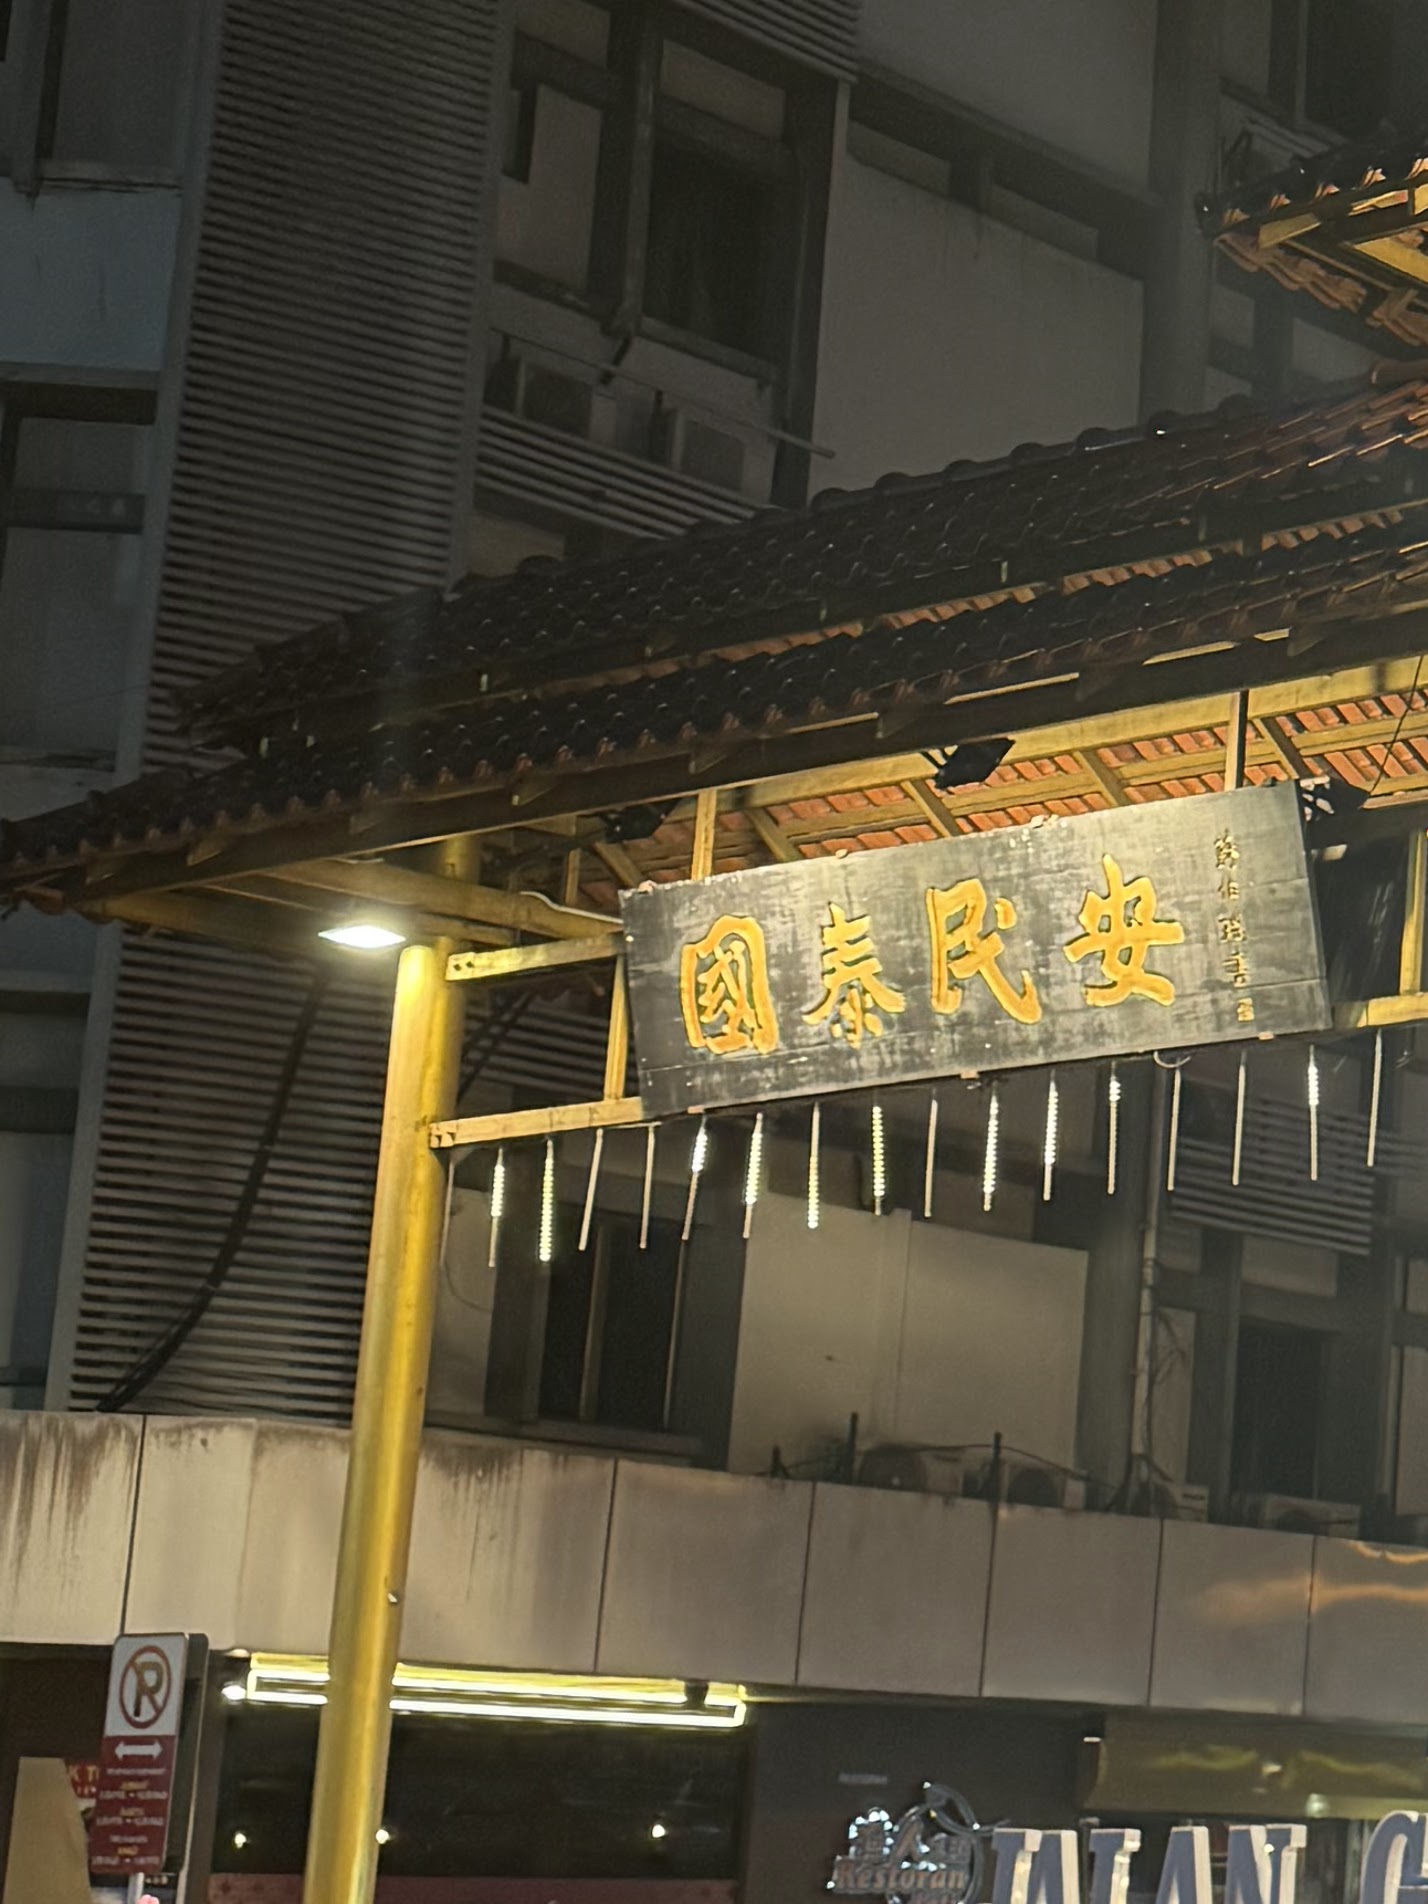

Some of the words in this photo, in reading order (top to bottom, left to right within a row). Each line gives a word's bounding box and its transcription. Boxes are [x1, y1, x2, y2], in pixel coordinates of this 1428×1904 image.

[679, 852, 1186, 1056] 國泰民安
[834, 1856, 966, 1892] Restoran
